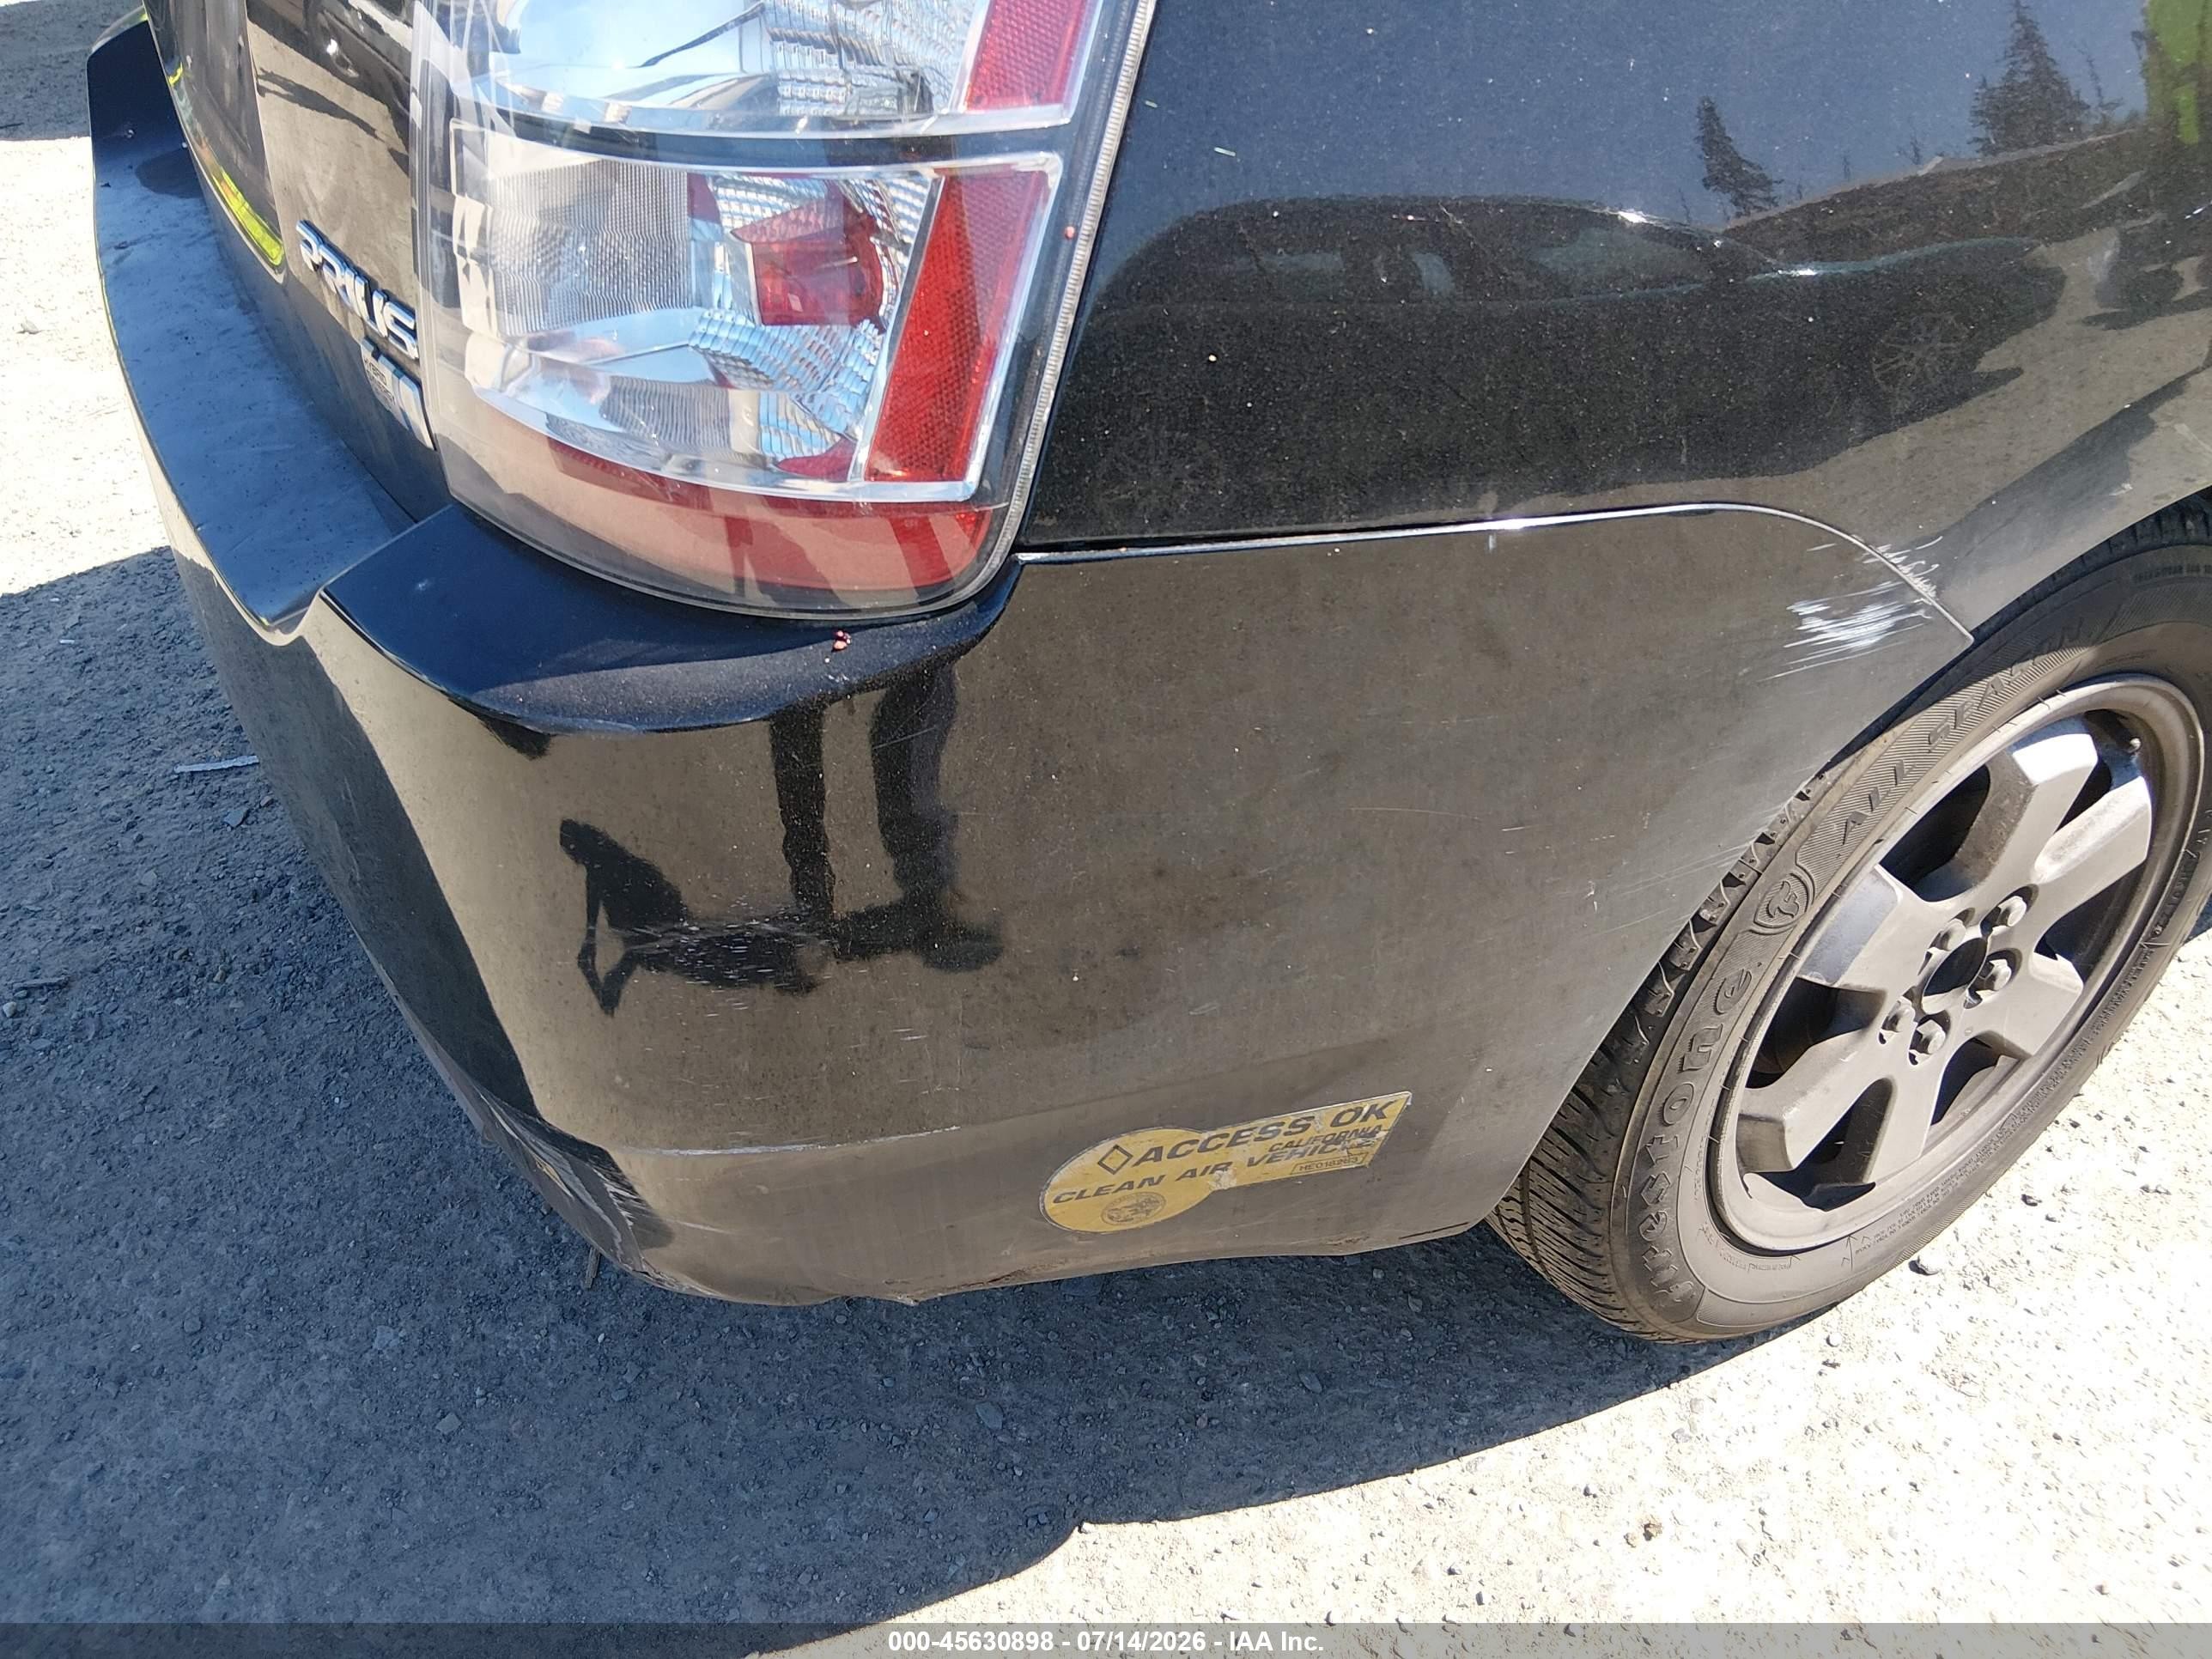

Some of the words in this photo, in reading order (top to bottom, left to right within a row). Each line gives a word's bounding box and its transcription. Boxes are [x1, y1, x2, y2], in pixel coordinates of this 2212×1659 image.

[295, 220, 419, 360] PRIUS
[1842, 759, 1917, 846] ALL
[1132, 1115, 1315, 1167] ACCESS
[1329, 1100, 1398, 1128] OK
[1268, 1124, 1383, 1152] CALIFORNIA
[1052, 1174, 1165, 1204] CLEAN
[1174, 1160, 1233, 1181] AIR
